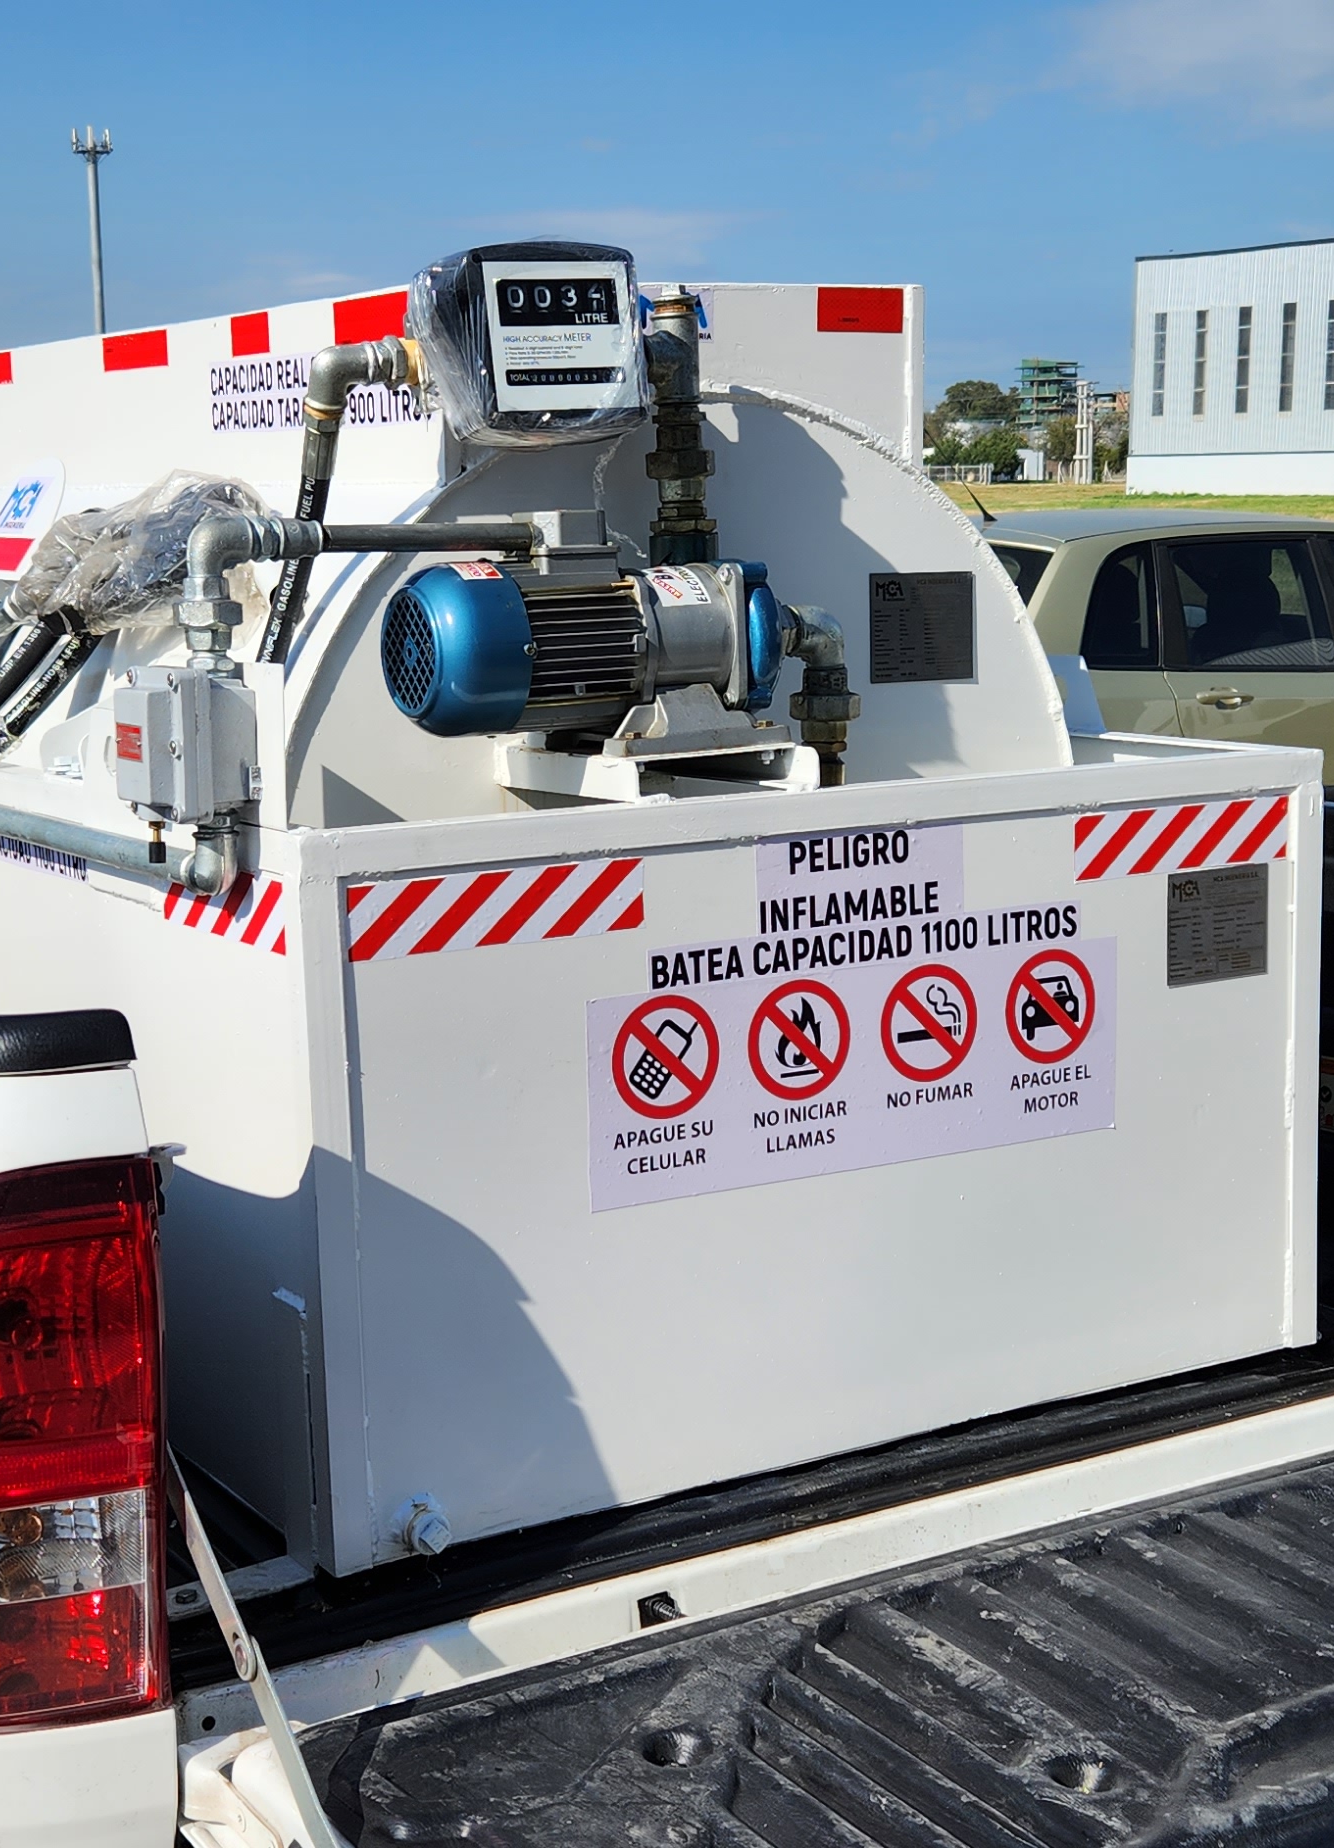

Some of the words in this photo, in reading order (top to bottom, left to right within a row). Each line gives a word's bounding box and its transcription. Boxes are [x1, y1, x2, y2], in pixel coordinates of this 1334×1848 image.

[574, 313, 609, 324] LITRE
[503, 335, 521, 343] HIGH
[522, 335, 562, 343] ACCURACY
[563, 332, 592, 342] METER
[210, 361, 273, 396] CAPACIDAD
[277, 357, 308, 390] REAL
[509, 373, 530, 382] TOTAL
[212, 399, 275, 431] CAPACIDAD
[277, 397, 305, 427] TAR
[349, 391, 375, 425] 900
[379, 389, 433, 423] LITR
[299, 493, 315, 519] FUEL
[307, 476, 316, 492] PU
[277, 558, 300, 612] GASOLINE
[13, 647, 26, 660] EN
[24, 628, 41, 648] 1360
[789, 829, 909, 875] PELIGRO
[58, 854, 88, 882] LITRO
[760, 881, 939, 934] INFLAMABLE
[650, 945, 743, 989] BATEA
[752, 923, 913, 976] CAPACIDAD
[920, 917, 978, 954] 1100
[987, 905, 1078, 947] LITROS
[1009, 1068, 1073, 1092] APAGUE
[1075, 1065, 1092, 1081] EL
[887, 1092, 911, 1109] NO
[914, 1082, 974, 1106] FUMAR
[1023, 1091, 1080, 1114] MOTOR
[754, 1112, 780, 1129] NO
[784, 1100, 848, 1125] INICIAR
[613, 1124, 687, 1151] APAGUE
[691, 1120, 715, 1138] SU
[766, 1128, 836, 1154] LLAMAS
[627, 1147, 707, 1176] CELULAR
